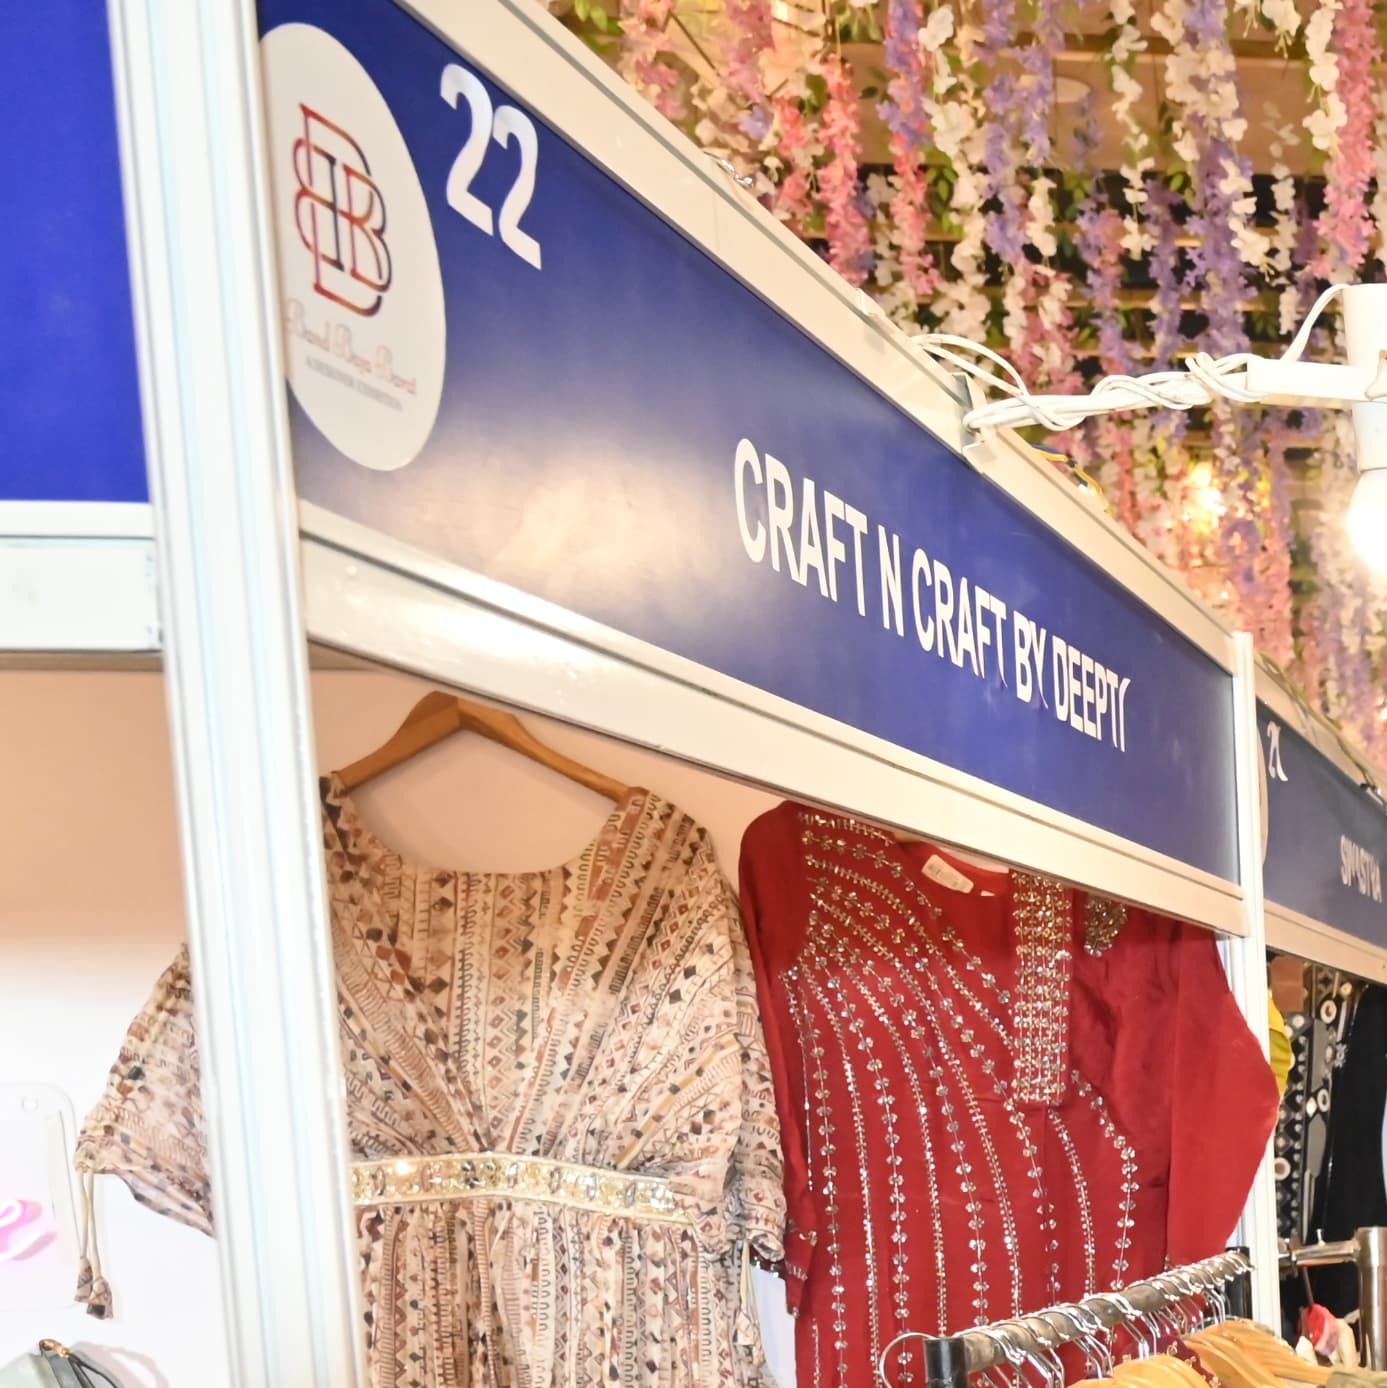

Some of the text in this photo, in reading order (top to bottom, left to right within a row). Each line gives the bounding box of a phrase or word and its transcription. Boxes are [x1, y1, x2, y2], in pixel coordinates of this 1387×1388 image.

[440, 62, 543, 271] 22
[734, 437, 868, 617] CRAFT
[878, 524, 904, 637] N
[912, 547, 1008, 689] CRAFT
[1013, 609, 1048, 710] BY
